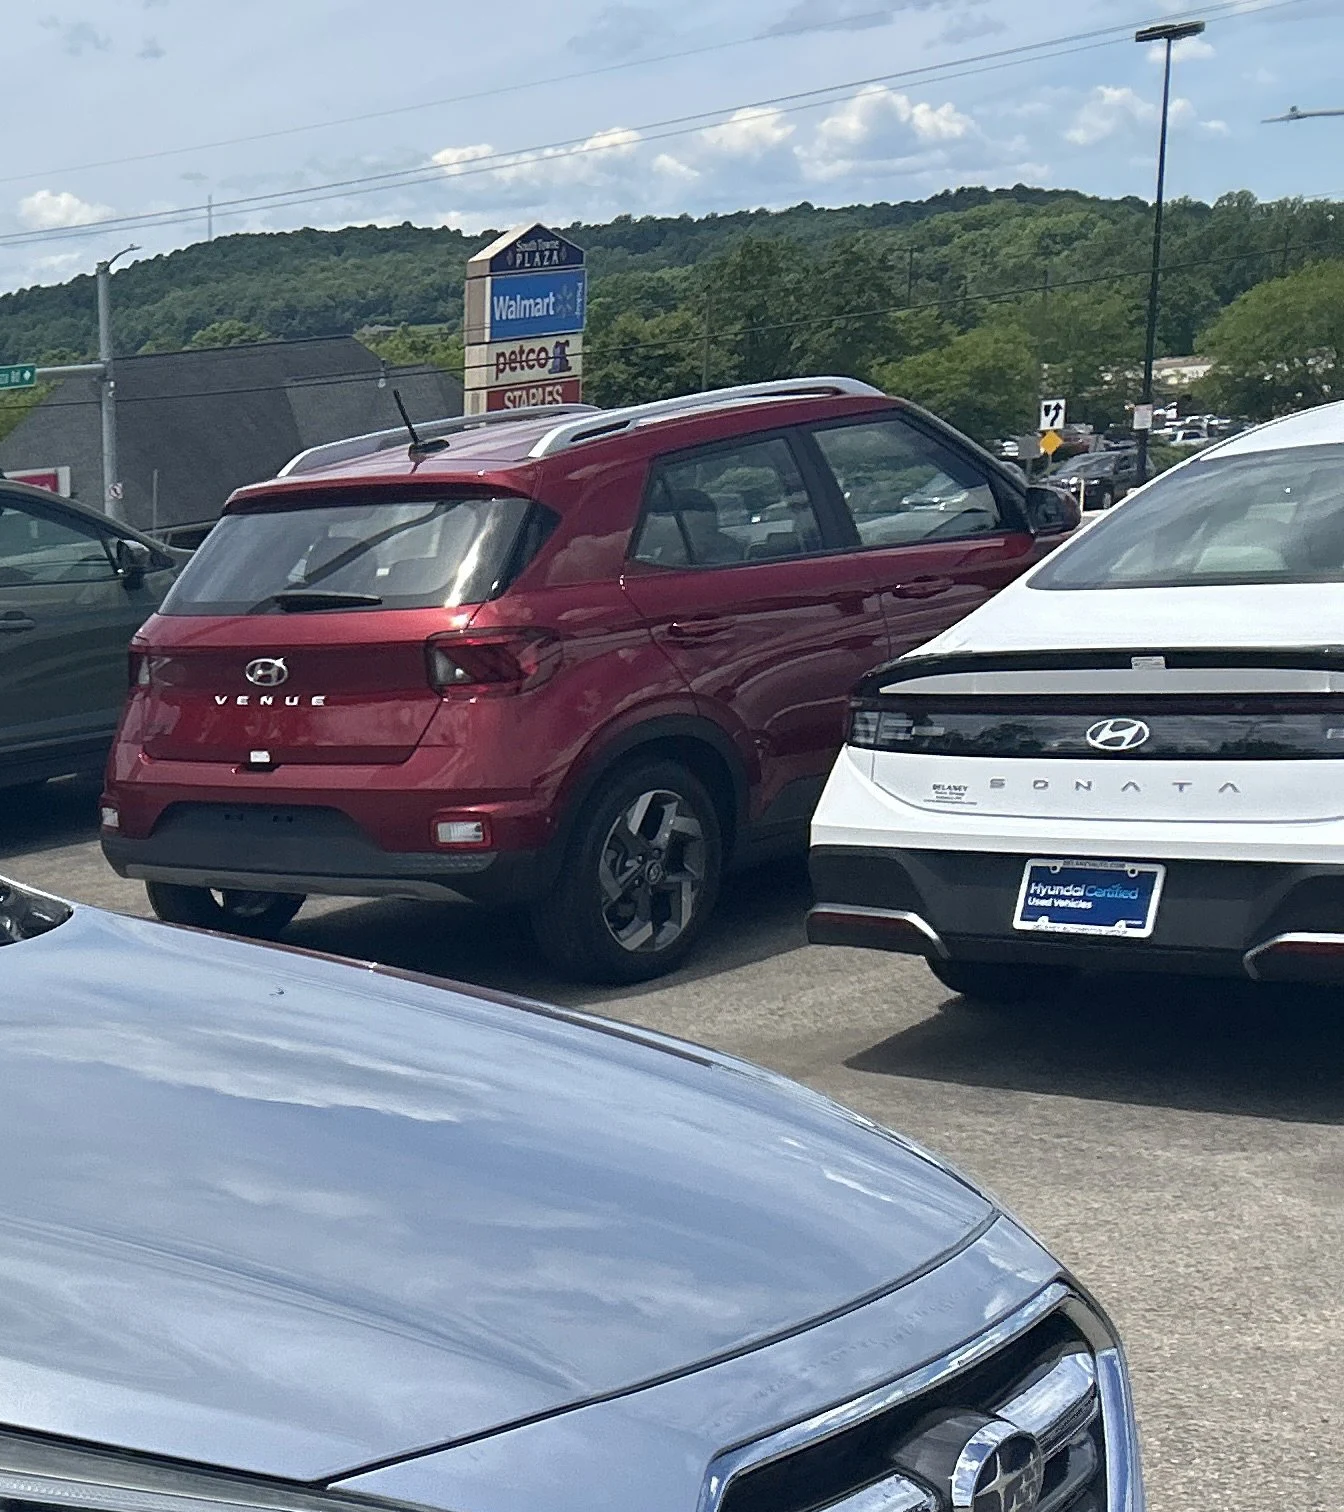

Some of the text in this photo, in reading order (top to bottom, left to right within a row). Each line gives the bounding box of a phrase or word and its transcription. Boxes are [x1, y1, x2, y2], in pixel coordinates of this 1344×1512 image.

[515, 250, 560, 268] PLAZA
[493, 292, 555, 321] Walmart
[495, 344, 549, 381] petco
[504, 385, 562, 410] STAPLES
[214, 695, 327, 706] VENUE
[989, 778, 1240, 793] SONATA
[1030, 882, 1139, 900] Hyundai Certified
[1027, 897, 1092, 909] Used Vehicles
